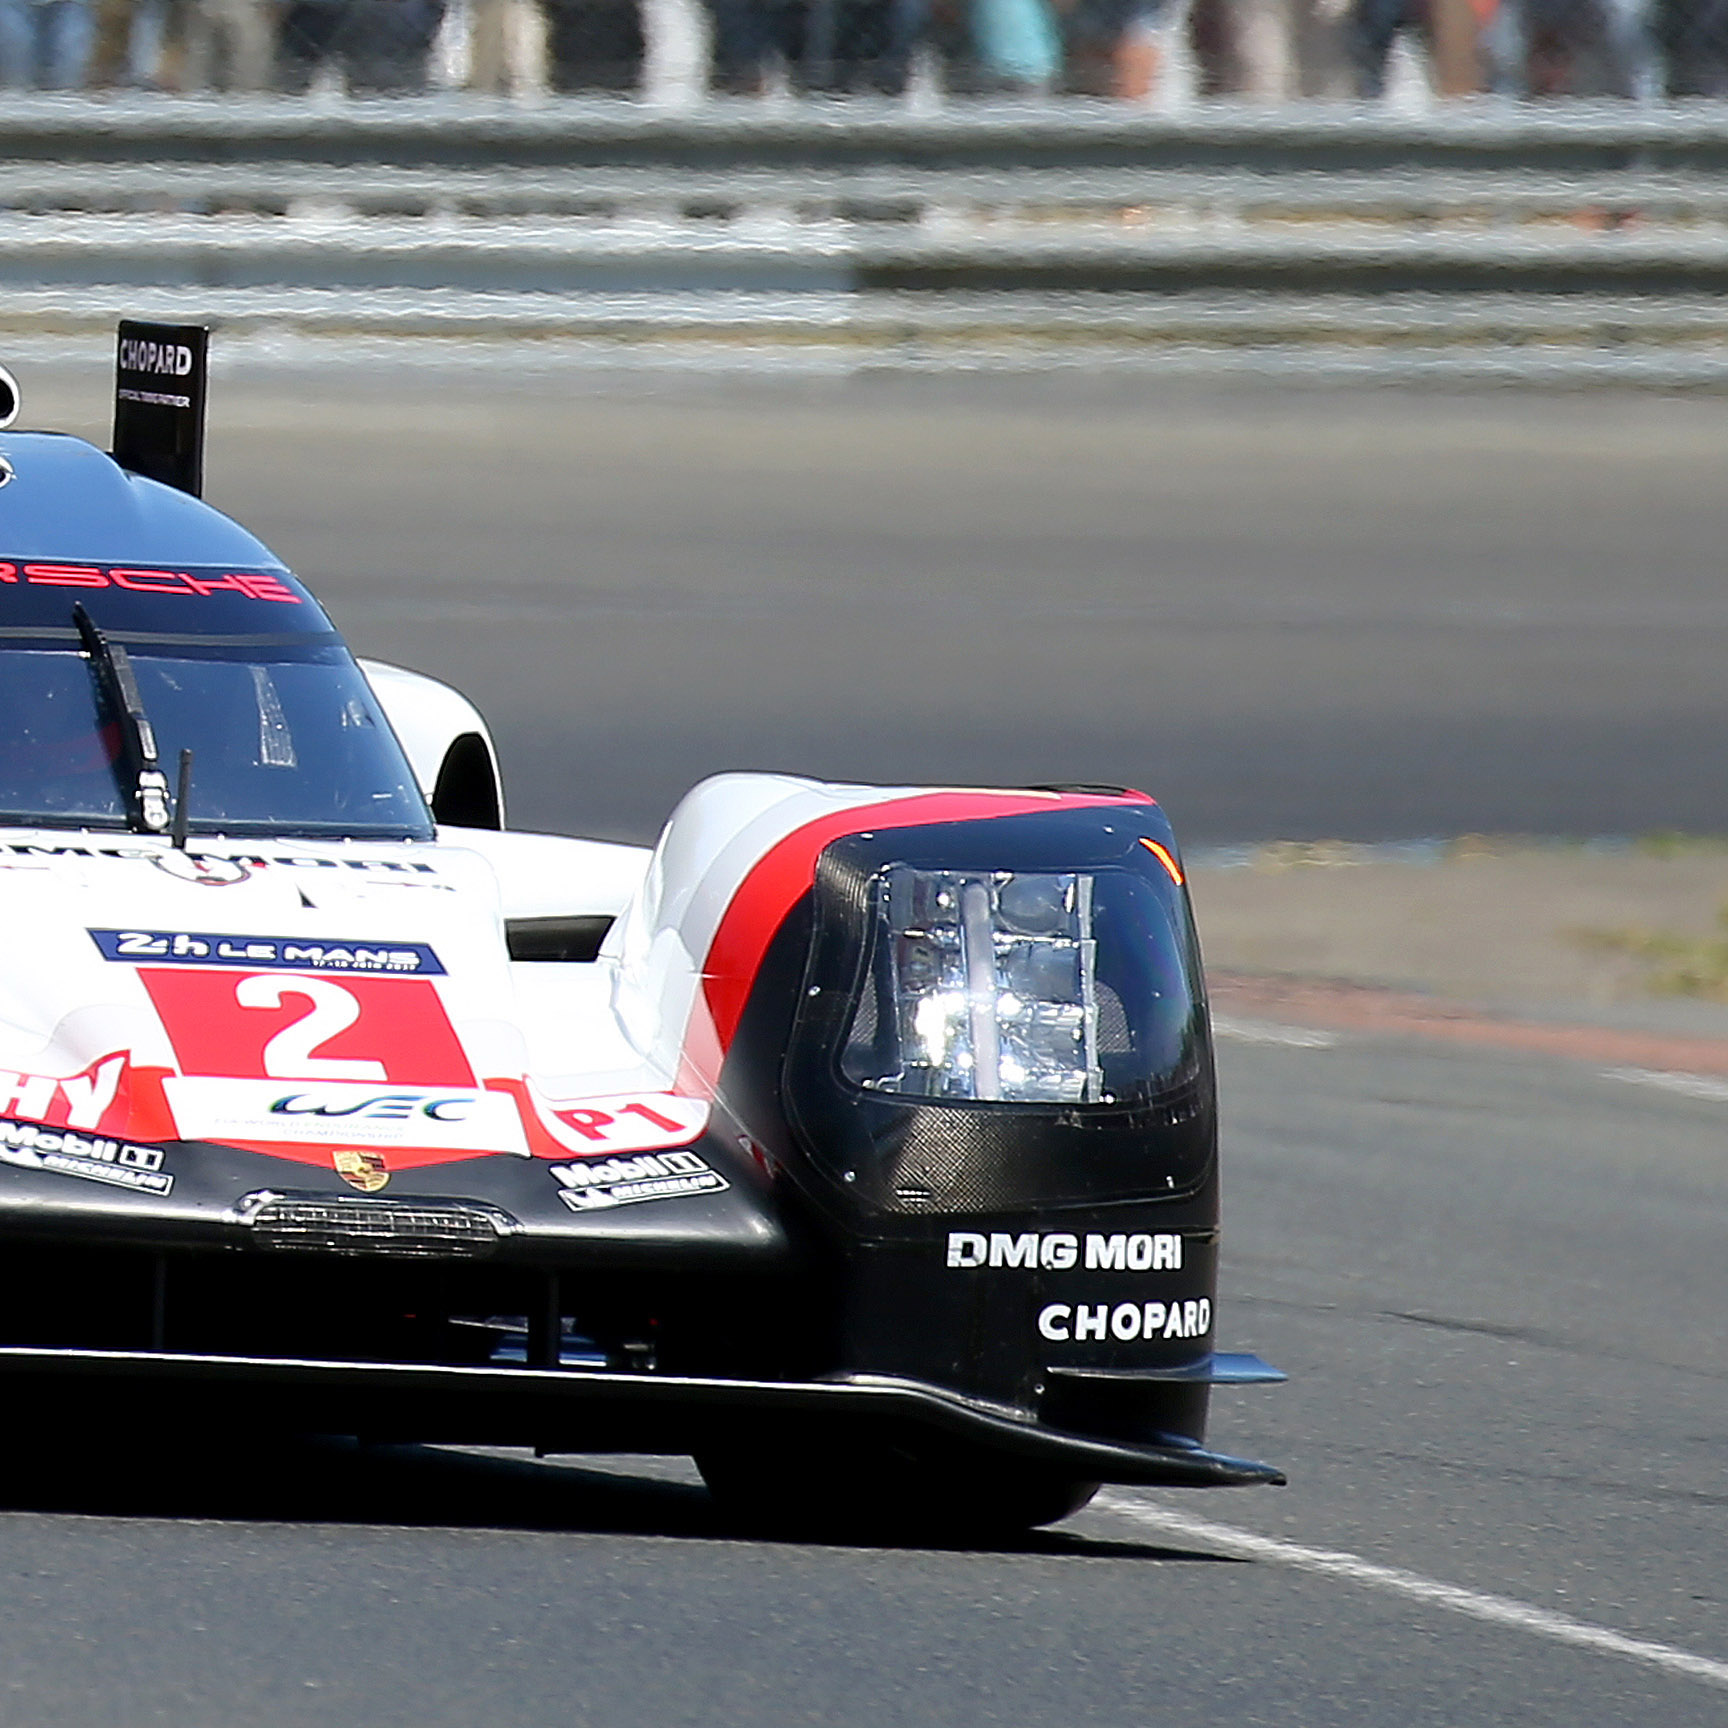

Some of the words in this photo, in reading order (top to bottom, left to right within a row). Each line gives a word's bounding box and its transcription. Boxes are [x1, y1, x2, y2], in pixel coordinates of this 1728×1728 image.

[120, 338, 193, 376] CHOPARD
[218, 942, 277, 960] LE
[283, 944, 420, 965] MANS
[234, 973, 389, 1082] 2
[268, 1094, 477, 1122] WEC
[554, 1103, 687, 1140] P1
[44, 1155, 169, 1190] MICHELIN
[550, 1153, 670, 1189] Mobil
[610, 1174, 718, 1198] MICHELIN
[946, 1231, 1078, 1270] DMG
[1085, 1233, 1182, 1270] MORI
[1038, 1298, 1212, 1341] CHOPARD
